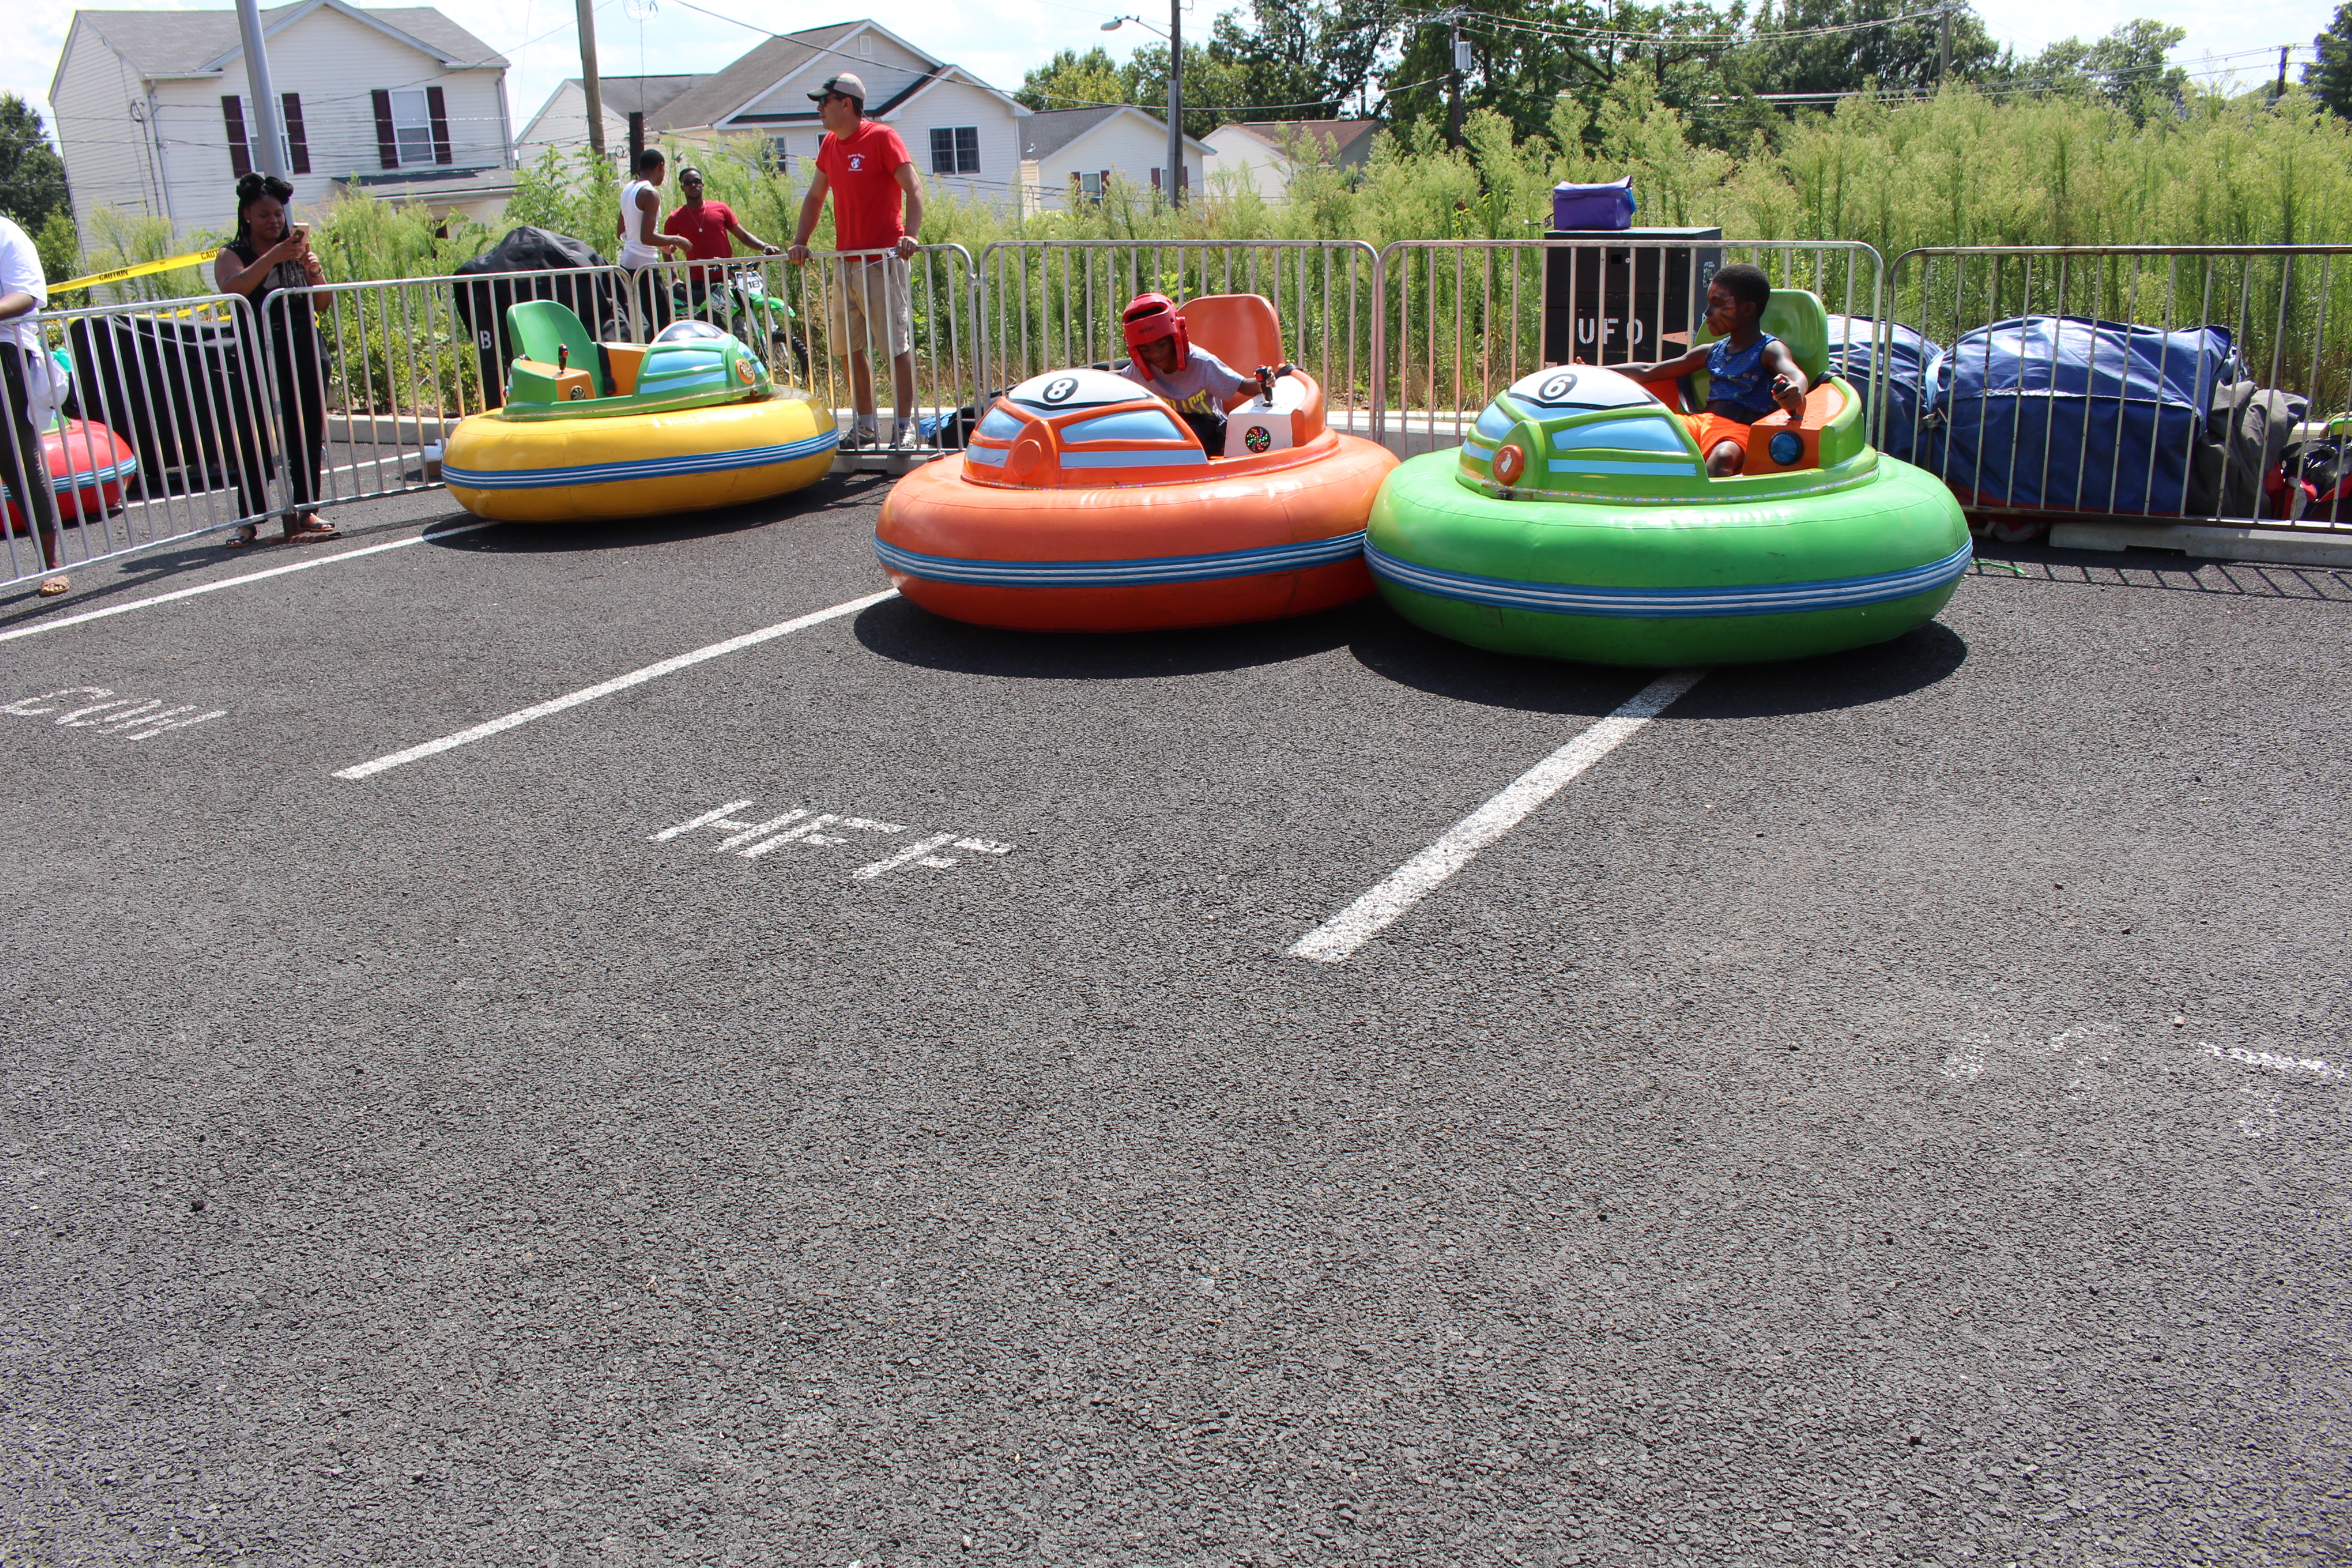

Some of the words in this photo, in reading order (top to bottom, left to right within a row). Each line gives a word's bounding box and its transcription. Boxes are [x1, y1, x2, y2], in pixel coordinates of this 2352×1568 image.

[200, 250, 218, 260] CAUT
[99, 270, 129, 280] CAUTION
[479, 330, 492, 350] B
[1578, 318, 1643, 344] UFO
[1047, 378, 1074, 400] 8
[1543, 375, 1572, 397] 6
[645, 799, 1017, 880] HFF
